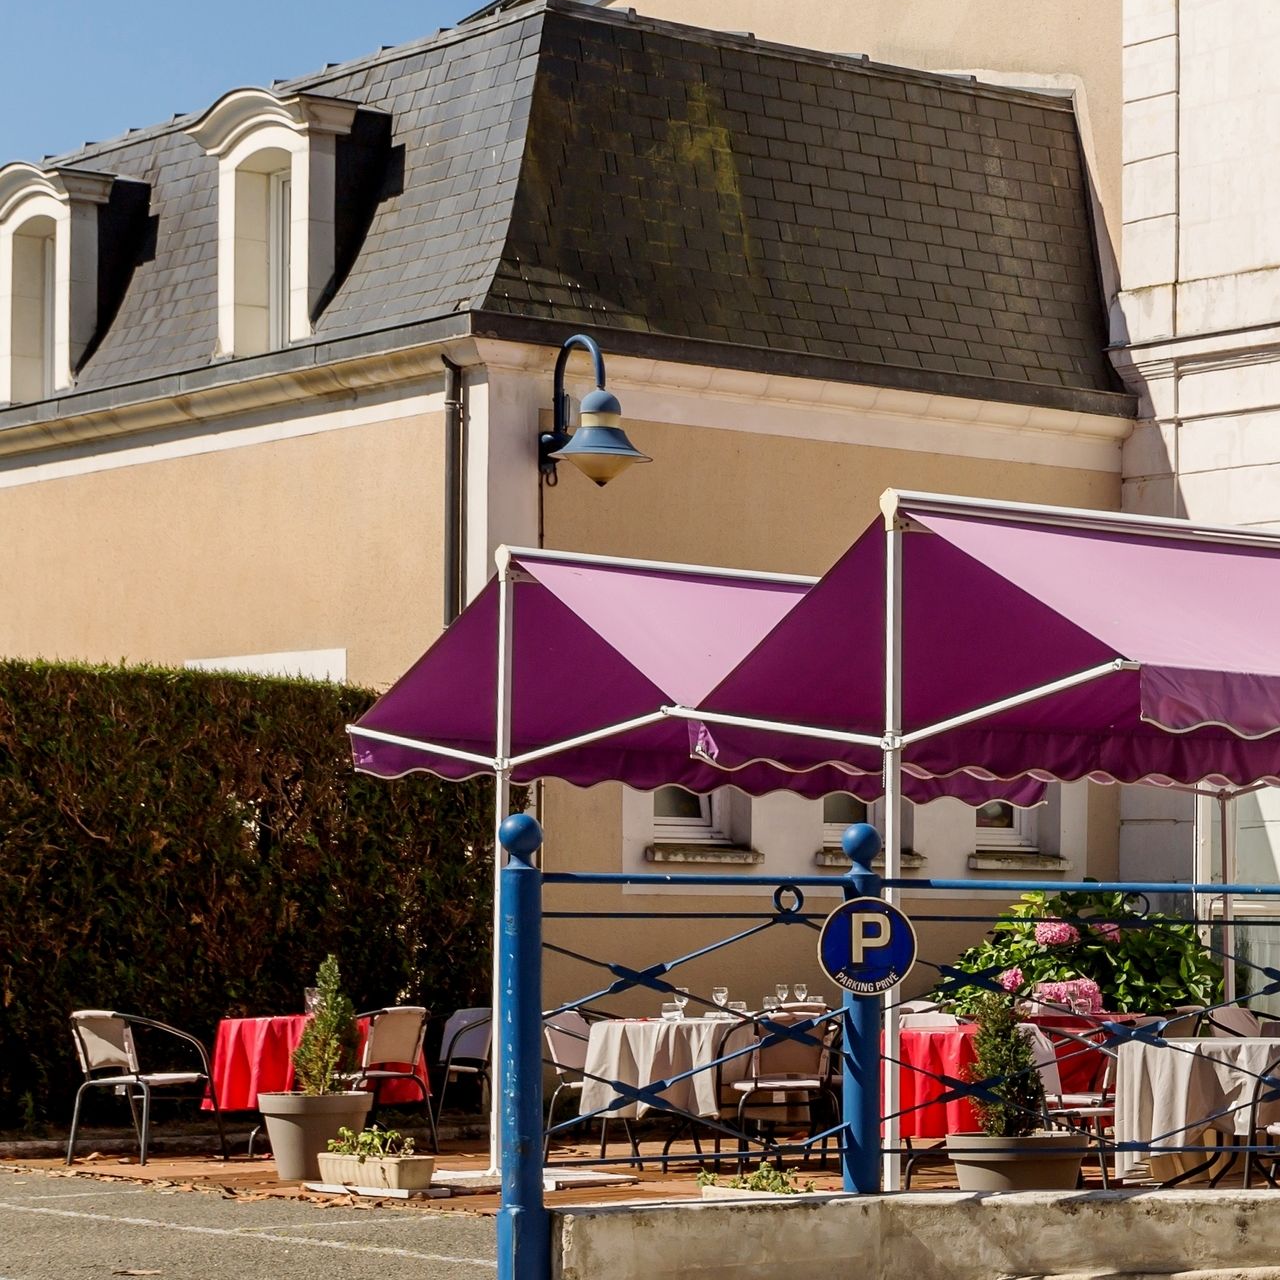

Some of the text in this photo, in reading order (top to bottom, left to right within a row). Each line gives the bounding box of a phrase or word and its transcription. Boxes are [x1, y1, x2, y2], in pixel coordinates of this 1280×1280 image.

[852, 912, 891, 964] P
[835, 970, 900, 992] PARKING PRIVÉ
